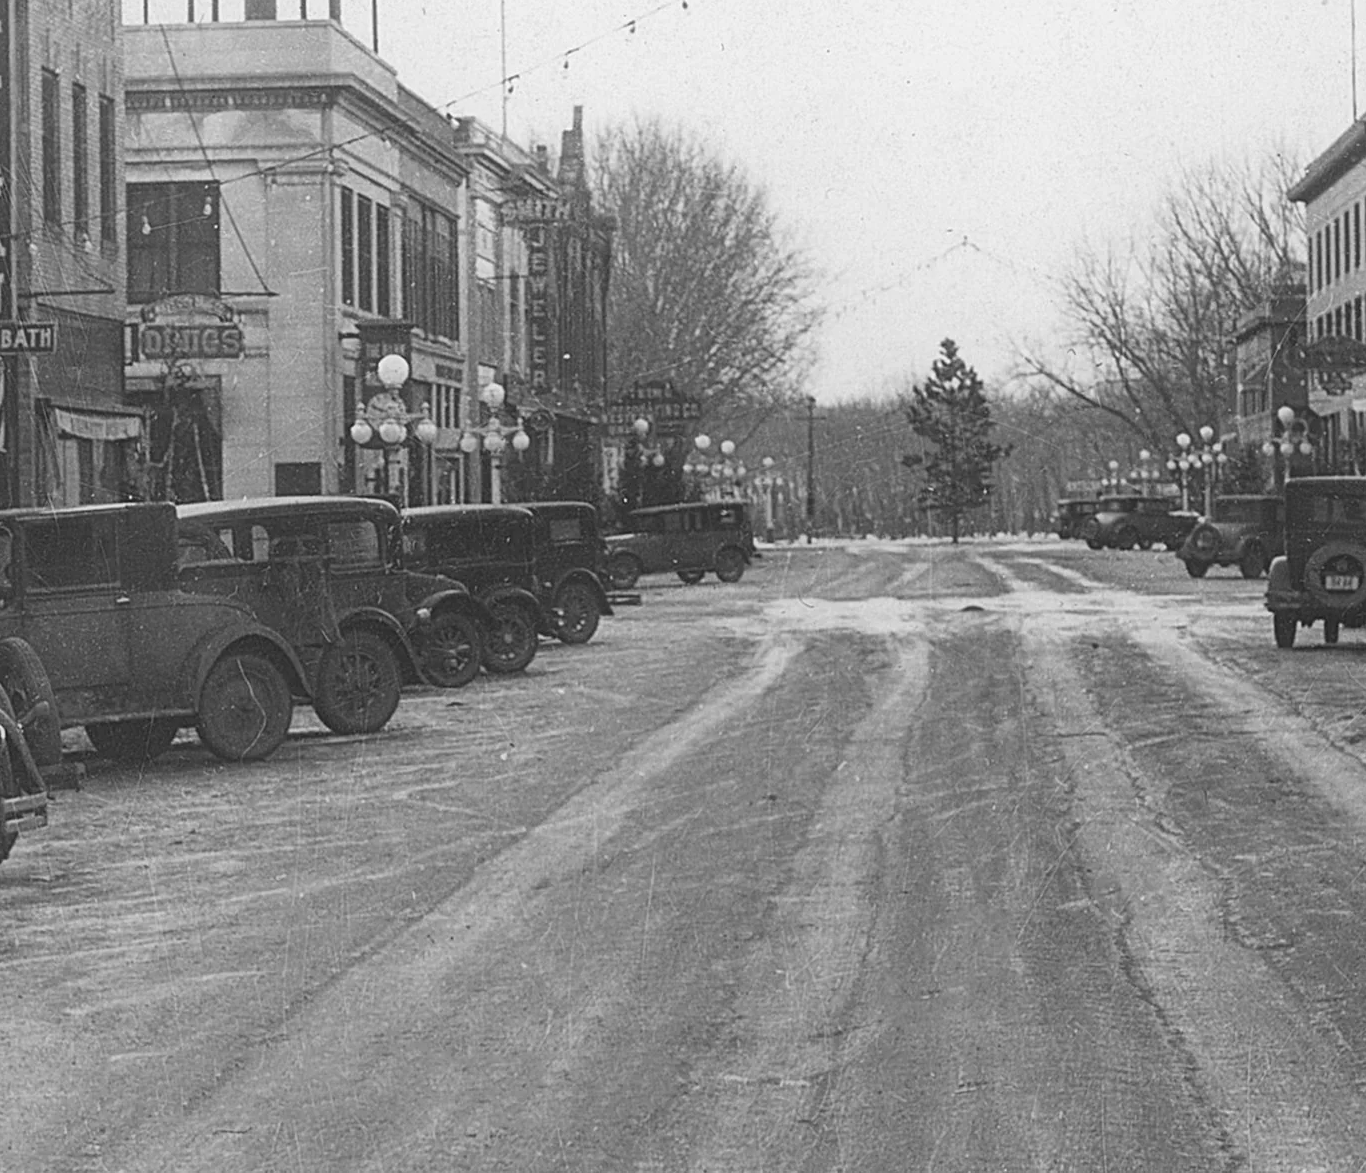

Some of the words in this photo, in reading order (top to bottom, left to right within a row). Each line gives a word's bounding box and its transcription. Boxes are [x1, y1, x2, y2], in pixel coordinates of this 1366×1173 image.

[531, 227, 547, 387] JEWELER
[0, 328, 52, 348] BATH
[144, 328, 241, 355] DRUGS
